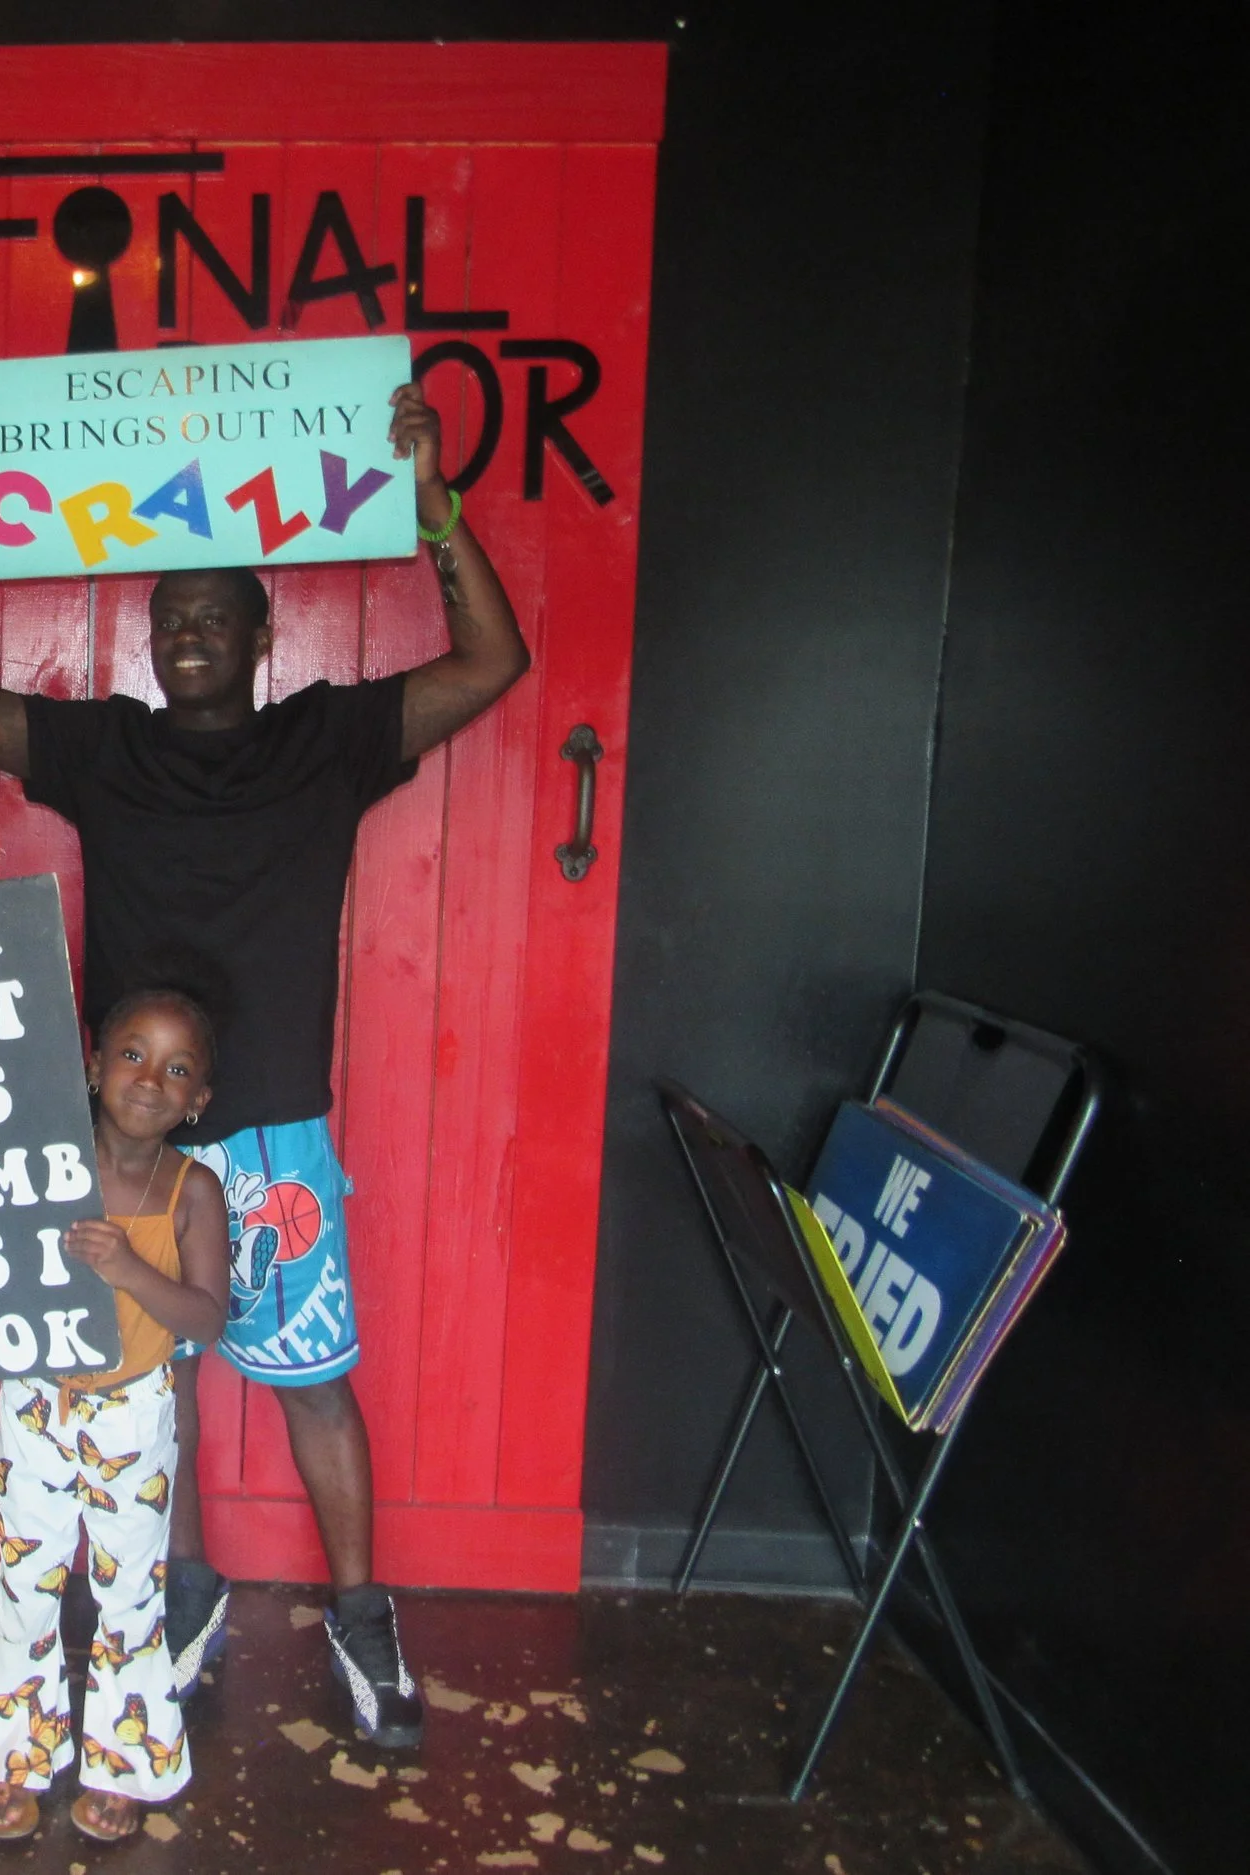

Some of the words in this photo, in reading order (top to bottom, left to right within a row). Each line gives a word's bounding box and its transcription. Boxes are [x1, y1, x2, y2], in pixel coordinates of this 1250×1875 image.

[65, 359, 292, 403] ESCAPING
[180, 409, 275, 445] OUT
[293, 404, 363, 438] MY
[873, 1153, 933, 1239] WE
[36, 1228, 71, 1287] I
